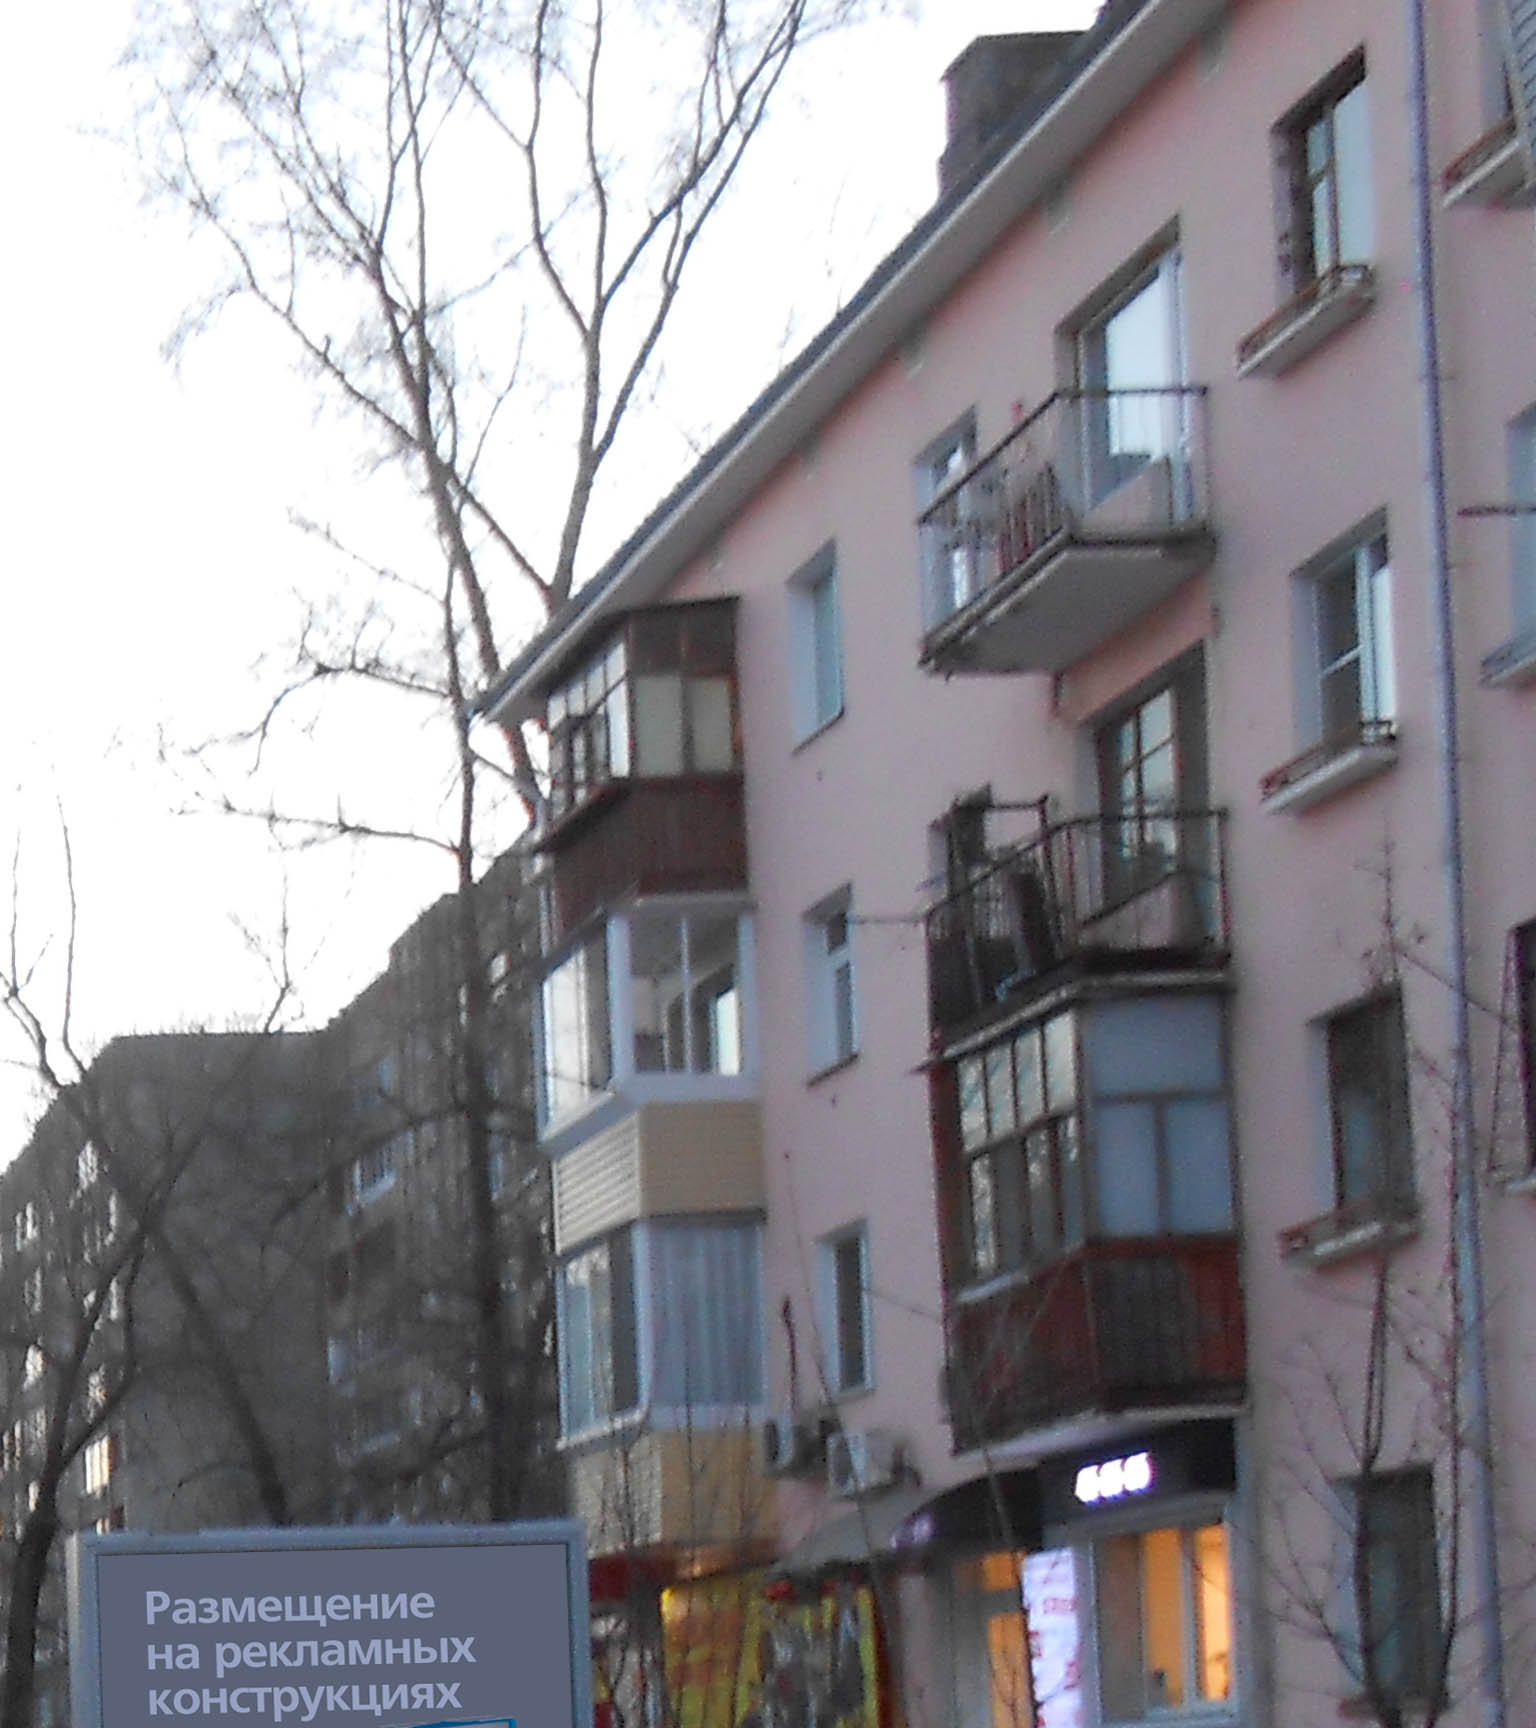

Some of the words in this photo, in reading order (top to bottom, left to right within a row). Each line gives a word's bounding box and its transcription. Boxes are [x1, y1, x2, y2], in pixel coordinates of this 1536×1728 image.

[146, 1591, 435, 1627] Размещение
[147, 1643, 200, 1670] на
[215, 1637, 477, 1678] рекламных
[149, 1682, 463, 1722] конструкциях
